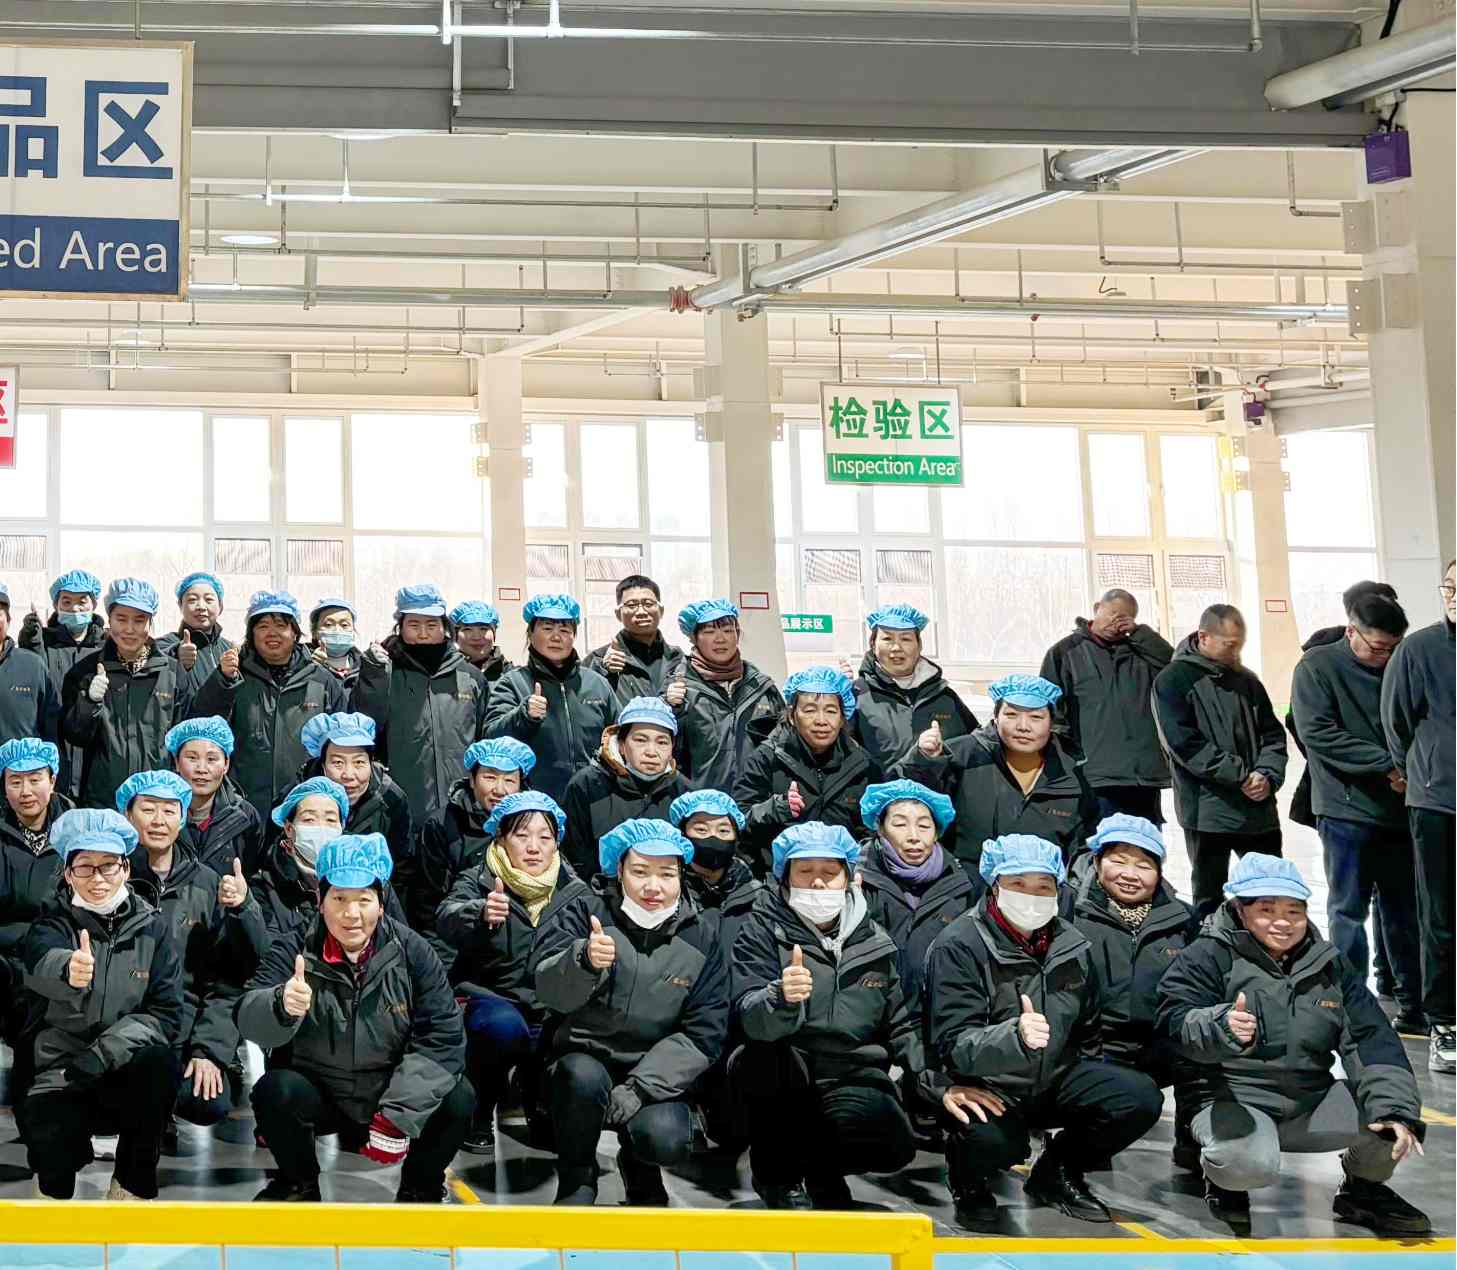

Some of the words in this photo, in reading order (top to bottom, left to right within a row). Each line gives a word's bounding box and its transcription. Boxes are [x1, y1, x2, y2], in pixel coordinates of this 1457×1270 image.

[58, 229, 168, 273] Area
[828, 396, 955, 440] 检验区
[832, 455, 914, 479] Inspection
